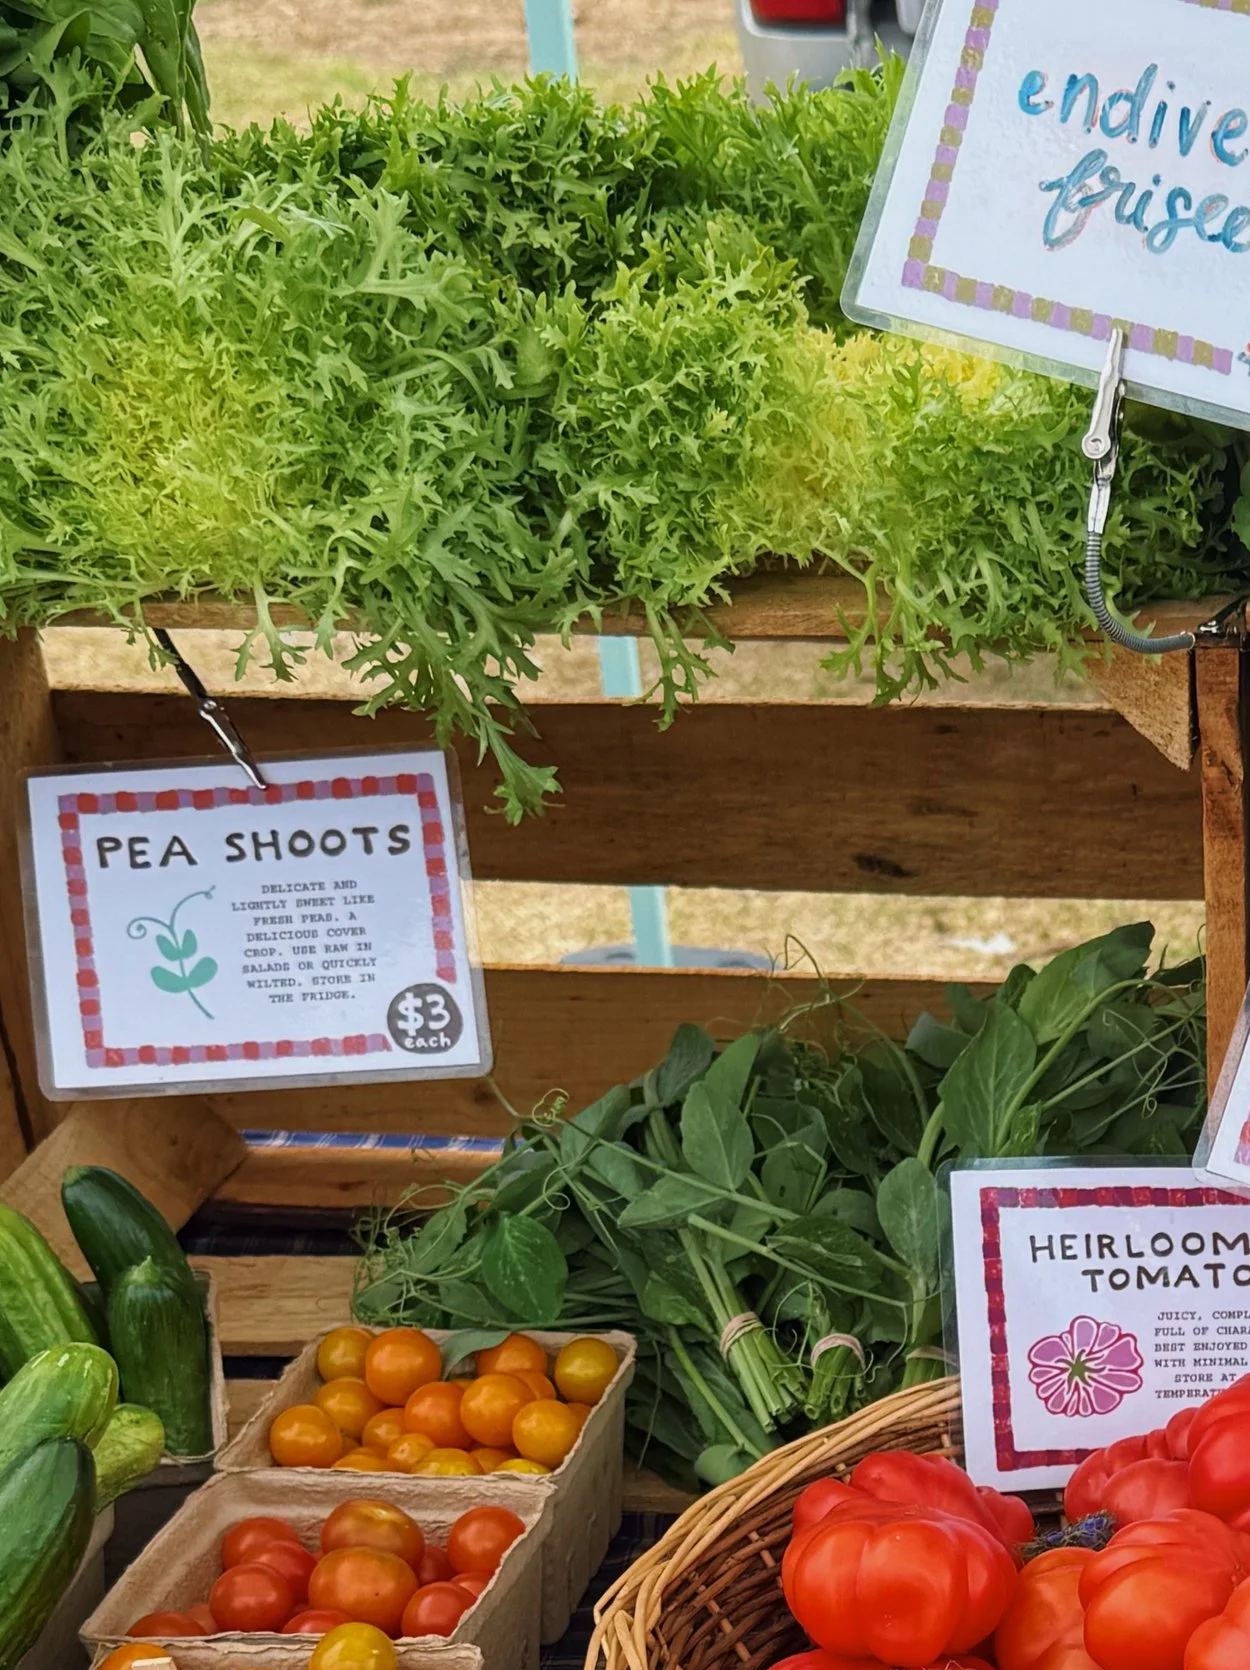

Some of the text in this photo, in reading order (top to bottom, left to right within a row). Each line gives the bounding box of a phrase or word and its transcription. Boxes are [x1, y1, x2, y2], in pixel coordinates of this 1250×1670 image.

[1017, 63, 1249, 167] endive
[97, 824, 411, 869] PEA SHOOTS
[261, 880, 357, 894] DELICATE AND
[231, 894, 375, 912] LIGHTLY SWEET LIKE
[253, 911, 357, 926] FRESH PEAS. A
[246, 926, 366, 943] DELICIOUS COVER
[244, 942, 372, 958] CROP. USE RAW IN
[242, 957, 377, 974] SALADS OR QUICKLY
[246, 973, 375, 989] WILTED. STORE IN
[268, 990, 355, 1004] THE FRIDGE.
[397, 992, 451, 1037] $3
[404, 1034, 451, 1049] each
[1029, 1231, 1250, 1263] HEIRLOOM
[1157, 1311, 1202, 1321] JUICY,
[1154, 1327, 1185, 1337] FULL
[1192, 1326, 1209, 1336] OF
[1154, 1342, 1186, 1352] BEST
[1193, 1342, 1248, 1351] ENJOYED
[1154, 1358, 1186, 1368] WITH
[1193, 1357, 1248, 1367] MINIMAL
[1174, 1373, 1238, 1384] STORE AT
